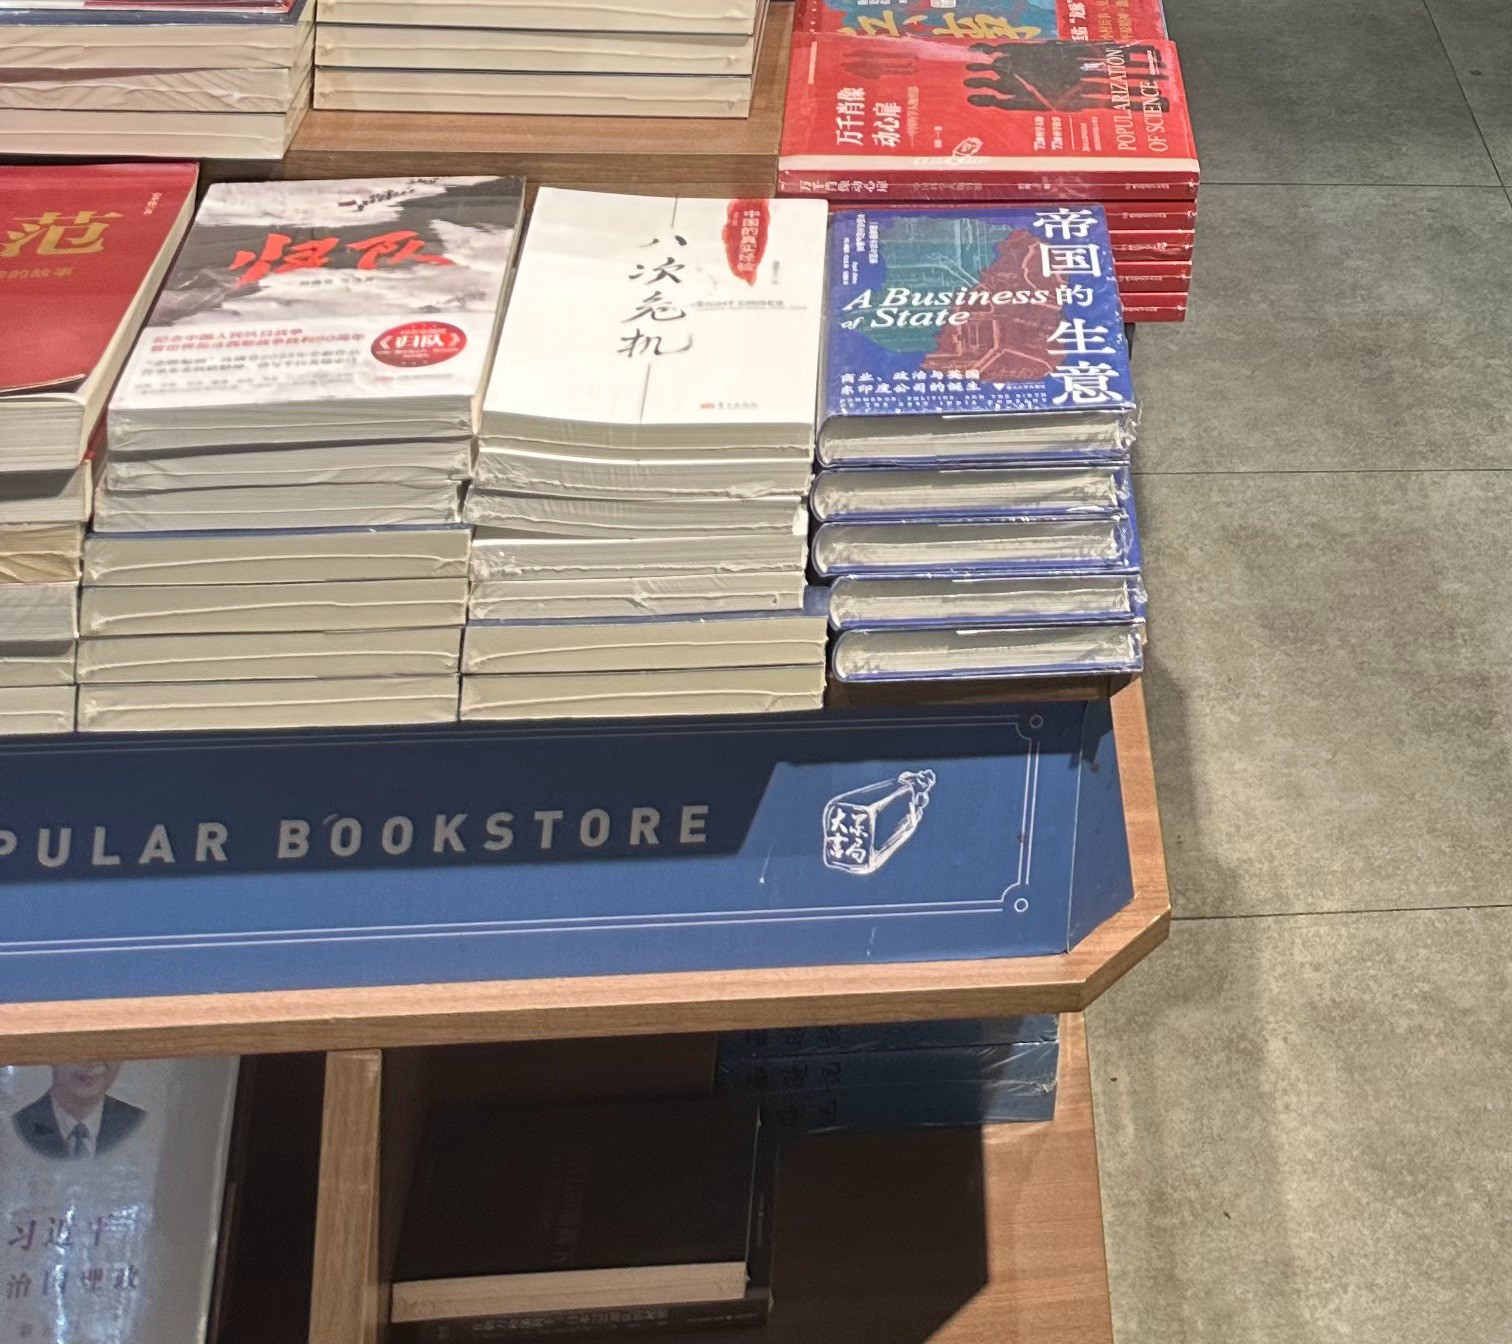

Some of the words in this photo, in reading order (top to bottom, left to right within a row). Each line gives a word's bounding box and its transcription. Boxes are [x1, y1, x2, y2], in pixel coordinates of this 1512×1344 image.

[835, 87, 866, 146] 万千肖像
[1105, 46, 1137, 151] POPULARIZATION
[1140, 79, 1171, 126] SCIENCE
[1150, 124, 1178, 152] OF
[840, 321, 866, 330] of
[870, 309, 971, 328] State
[842, 288, 874, 310] A
[885, 287, 1050, 306] Business
[1032, 208, 1124, 405] 帝国的生意
[277, 803, 713, 860] BOOKSTORE
